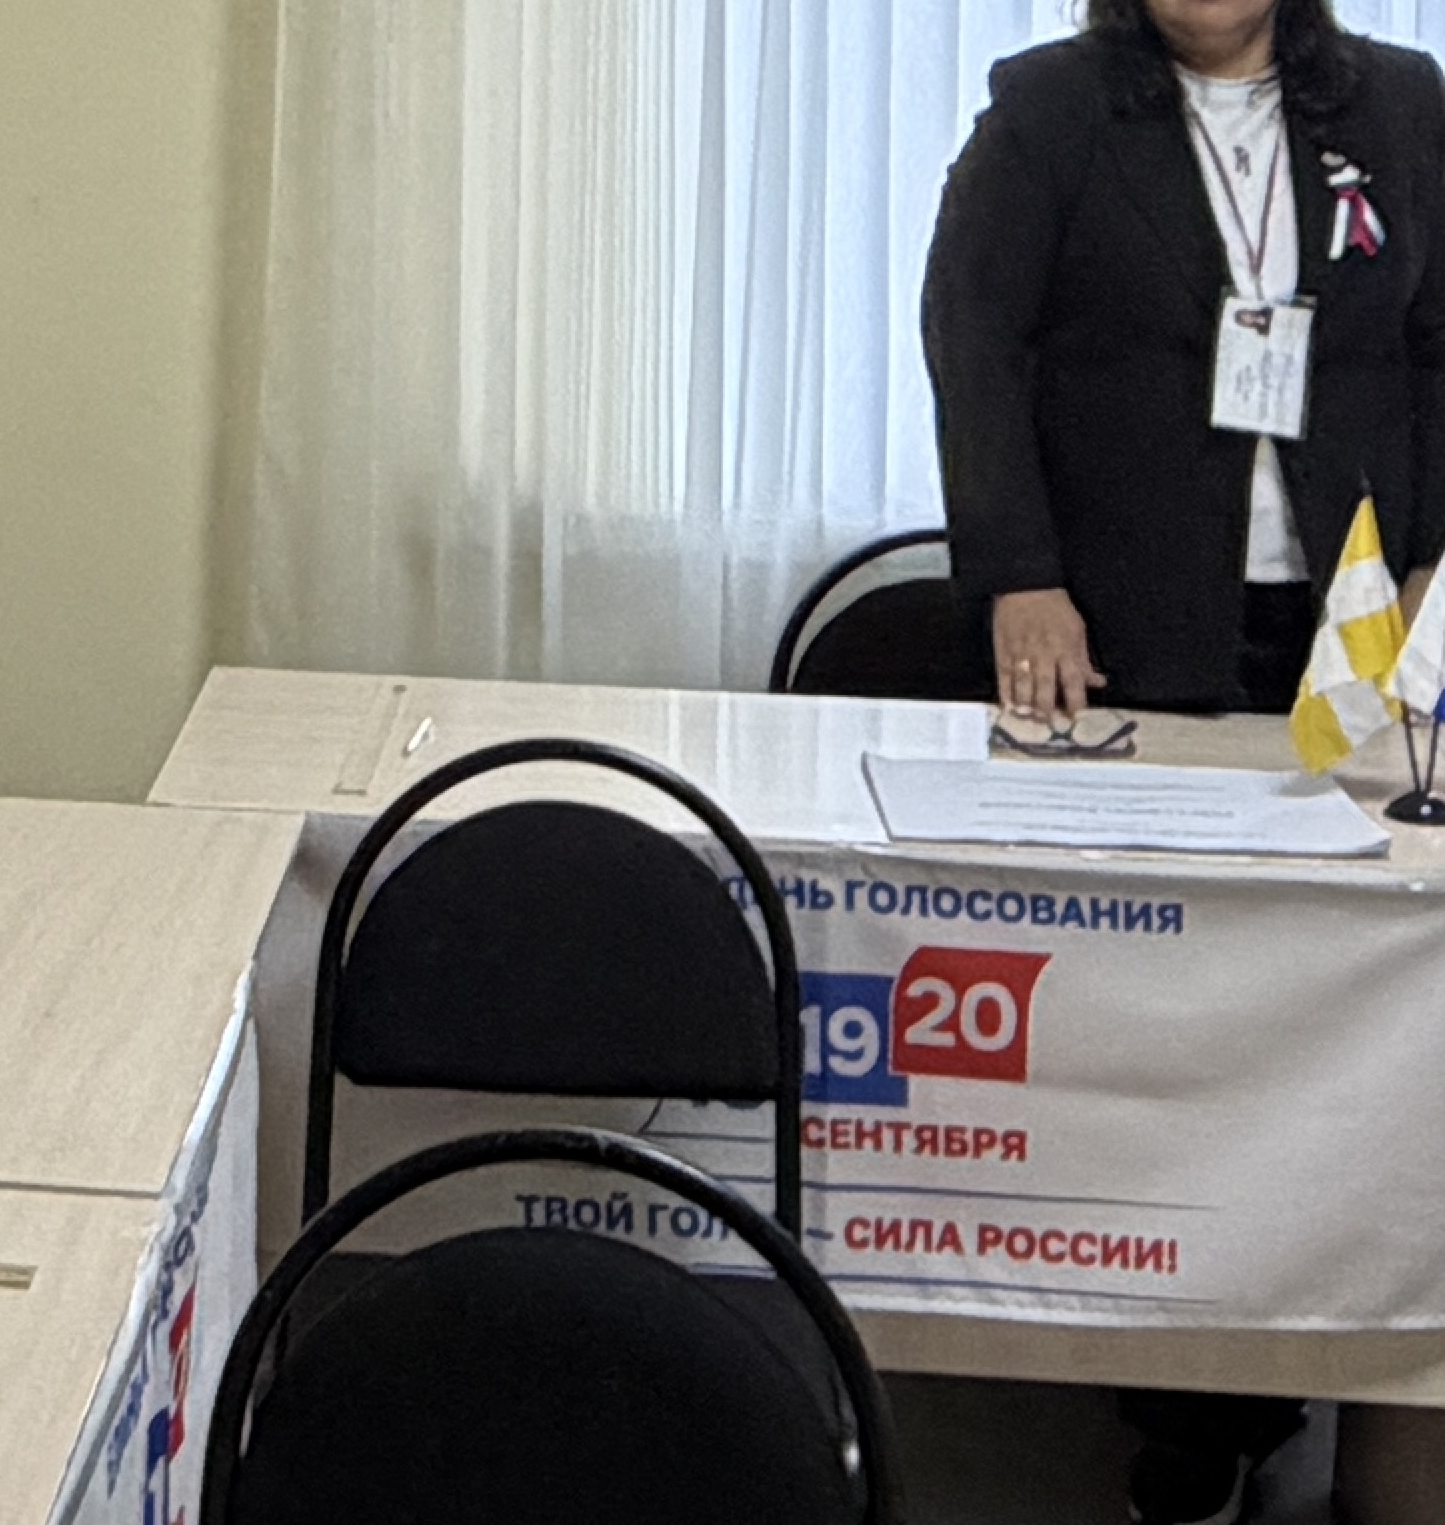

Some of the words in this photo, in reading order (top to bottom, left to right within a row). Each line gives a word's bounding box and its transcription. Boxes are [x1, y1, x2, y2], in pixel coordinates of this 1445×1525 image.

[845, 880, 1184, 935] ГОЛОСОВАНИЯ
[799, 1005, 880, 1077] 19
[904, 977, 1018, 1052] 20
[800, 1116, 1029, 1162] СЕНТЯБРЯ
[515, 1192, 634, 1235] ТВОЙ
[844, 1216, 965, 1257] СИЛА
[976, 1223, 1178, 1274] РОССИИ!
